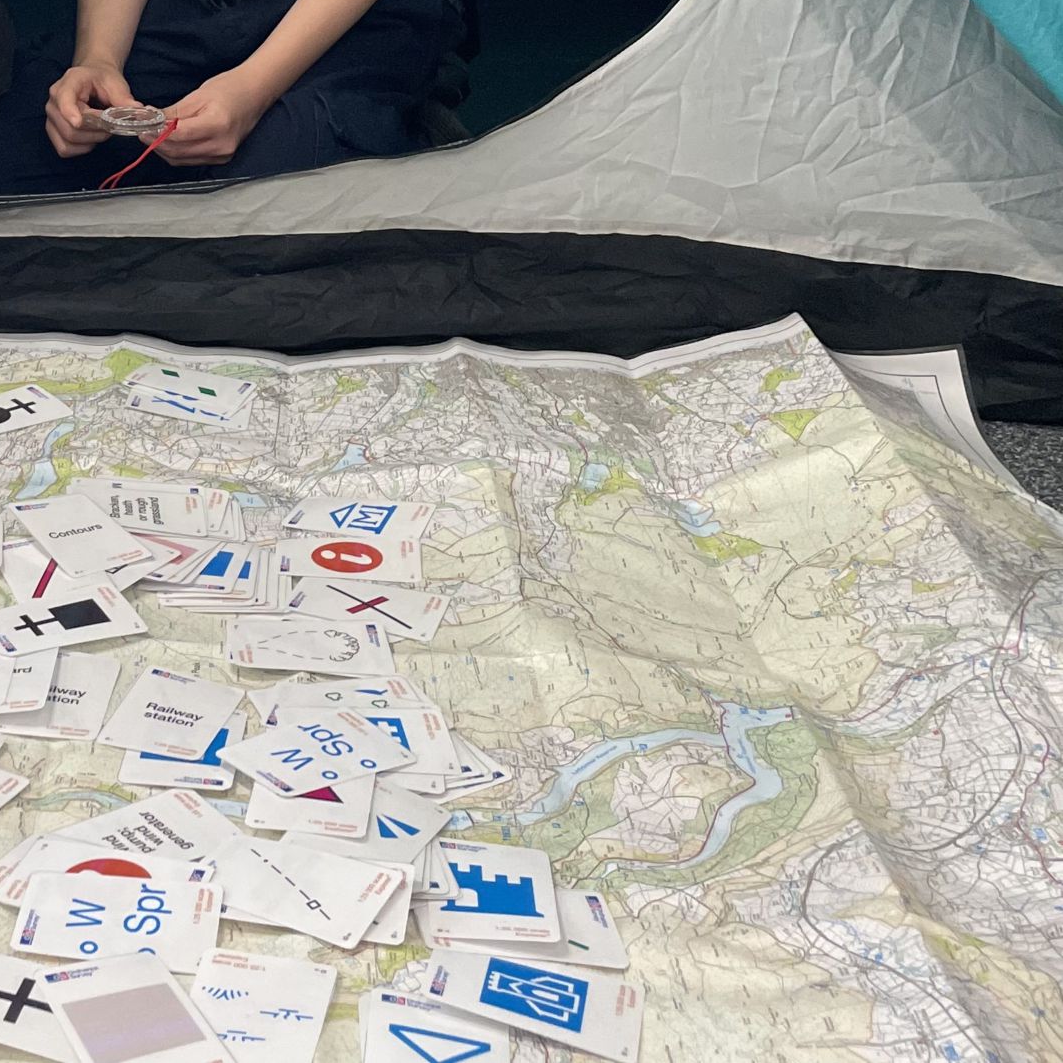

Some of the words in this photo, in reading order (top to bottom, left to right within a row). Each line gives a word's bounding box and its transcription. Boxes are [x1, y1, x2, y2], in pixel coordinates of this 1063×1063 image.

[148, 496, 164, 525] grassland
[49, 523, 103, 539] Contours
[48, 686, 87, 699] ilway
[144, 710, 195, 728] station
[146, 702, 204, 722] Railway
[297, 723, 354, 758] Spr
[270, 747, 314, 772] W
[133, 825, 164, 846] wind
[138, 811, 195, 849] generator
[65, 898, 106, 927] W
[123, 883, 173, 935] Spr
